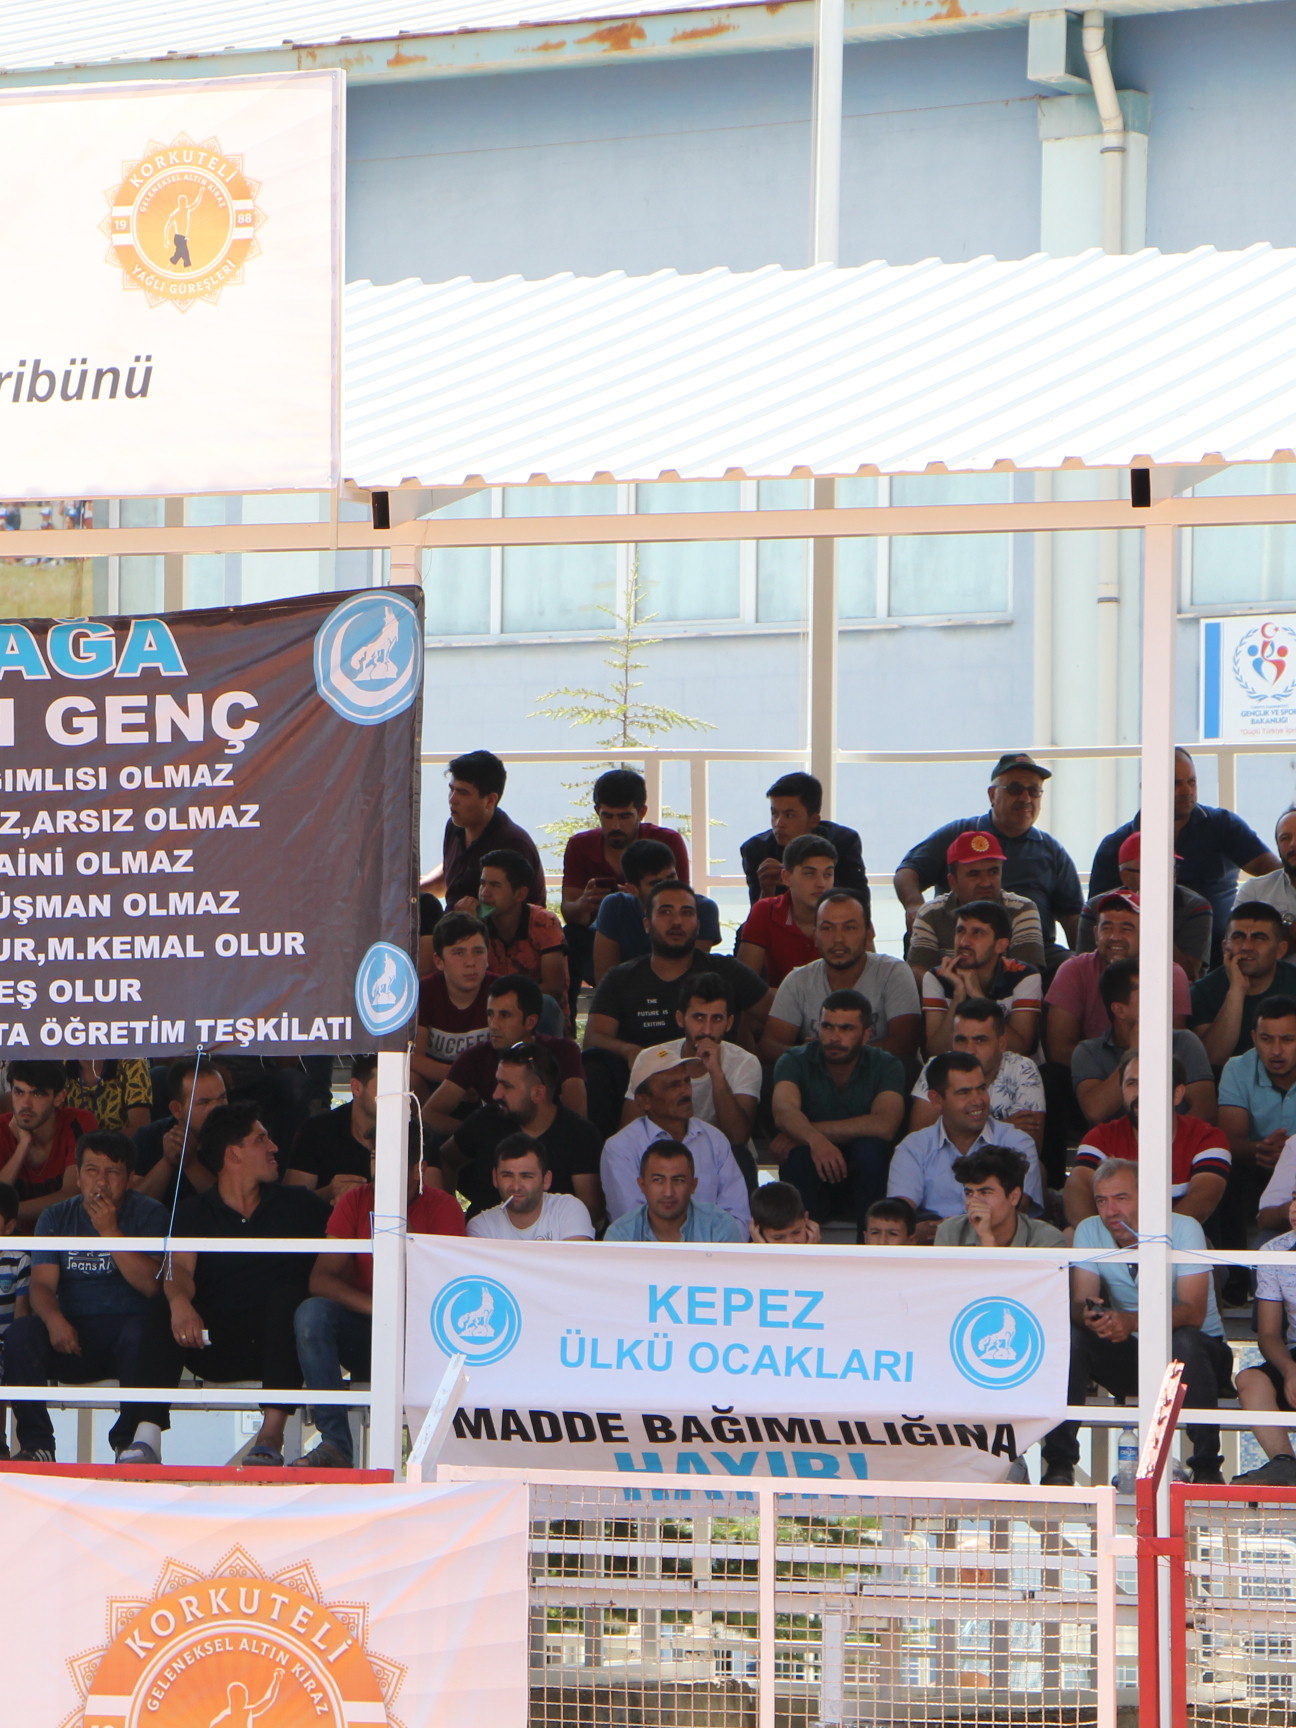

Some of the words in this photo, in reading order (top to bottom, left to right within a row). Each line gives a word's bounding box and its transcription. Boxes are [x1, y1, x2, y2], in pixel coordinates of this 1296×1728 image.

[129, 150, 239, 188] KORKUTELİ
[139, 176, 182, 212] GELENEKSEL
[183, 174, 208, 186] ALTIN
[114, 220, 127, 230] 19
[238, 214, 252, 224] 88
[132, 263, 165, 292] YAĞLI
[169, 259, 237, 294] GÜREŞLERİ
[44, 691, 260, 754] GENÇ
[118, 763, 234, 790] OLMAZ
[144, 804, 261, 831] OLMAZ
[75, 849, 194, 876] OLMAZ
[122, 890, 241, 918] OLMAZ
[214, 931, 306, 958] OLUR
[48, 978, 142, 1004] OLUR
[39, 1014, 186, 1046] ÖĞRETİM
[194, 1012, 353, 1048] TEŞKİLATI
[648, 1284, 825, 1330] KEPEZ
[559, 1328, 673, 1371] ÜLKÜ
[688, 1341, 914, 1383] OCAKLARI
[452, 1407, 629, 1444] MADDE
[641, 1404, 1018, 1462] BAĞIMLILIĞINA
[124, 1586, 356, 1664] KORKUTELİ
[146, 1637, 234, 1713] GELENEKSEL
[239, 1638, 290, 1666] ALTIN
[290, 1662, 329, 1715] KİRAZ
